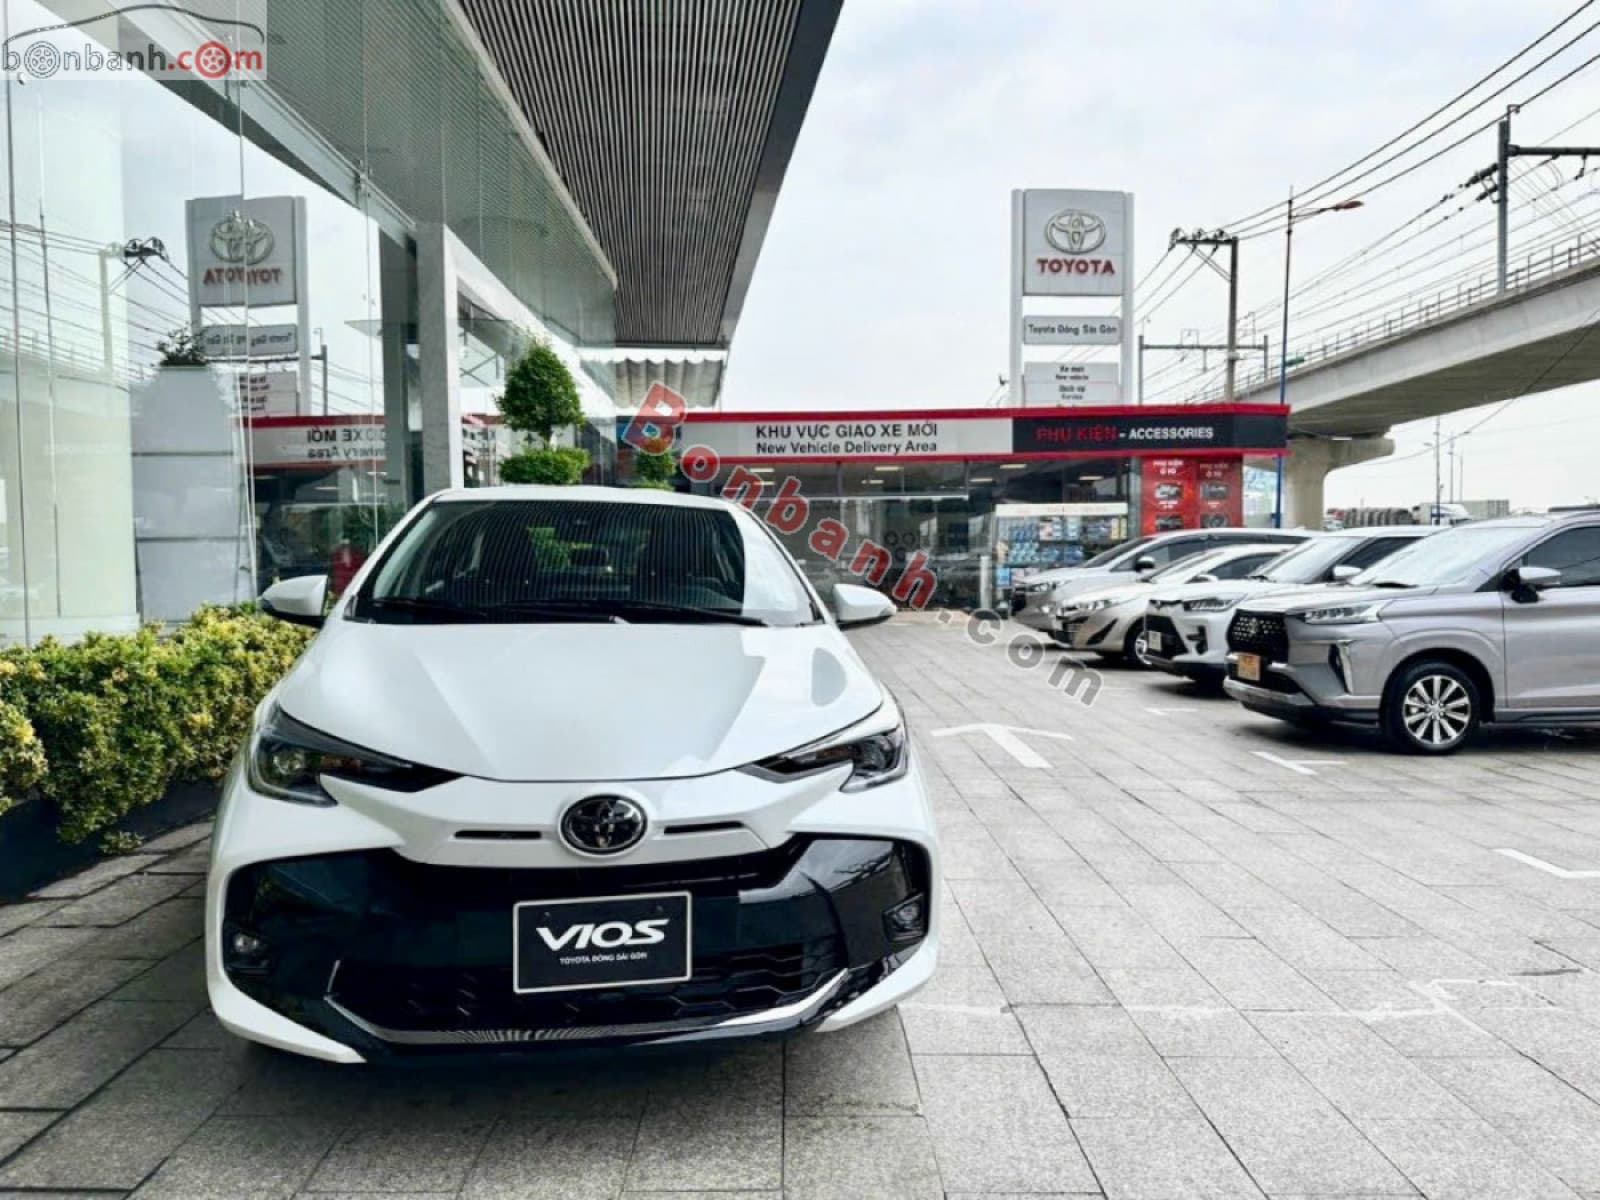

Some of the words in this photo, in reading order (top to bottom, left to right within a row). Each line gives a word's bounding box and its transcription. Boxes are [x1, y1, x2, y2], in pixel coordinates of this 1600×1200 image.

[1036, 258, 1116, 275] TOYOTA
[756, 424, 792, 438] KHU
[797, 423, 830, 440] VỰC
[835, 423, 876, 437] GIAO
[881, 423, 902, 437] XE
[908, 420, 937, 436] MỚI
[1128, 426, 1214, 440] ACCESSORIES
[756, 441, 786, 454] New
[791, 441, 840, 454] Vehicle
[844, 440, 900, 455] Delivery
[905, 439, 938, 452] Area
[536, 918, 670, 951] VIOS
[560, 956, 591, 965] TOYOTA
